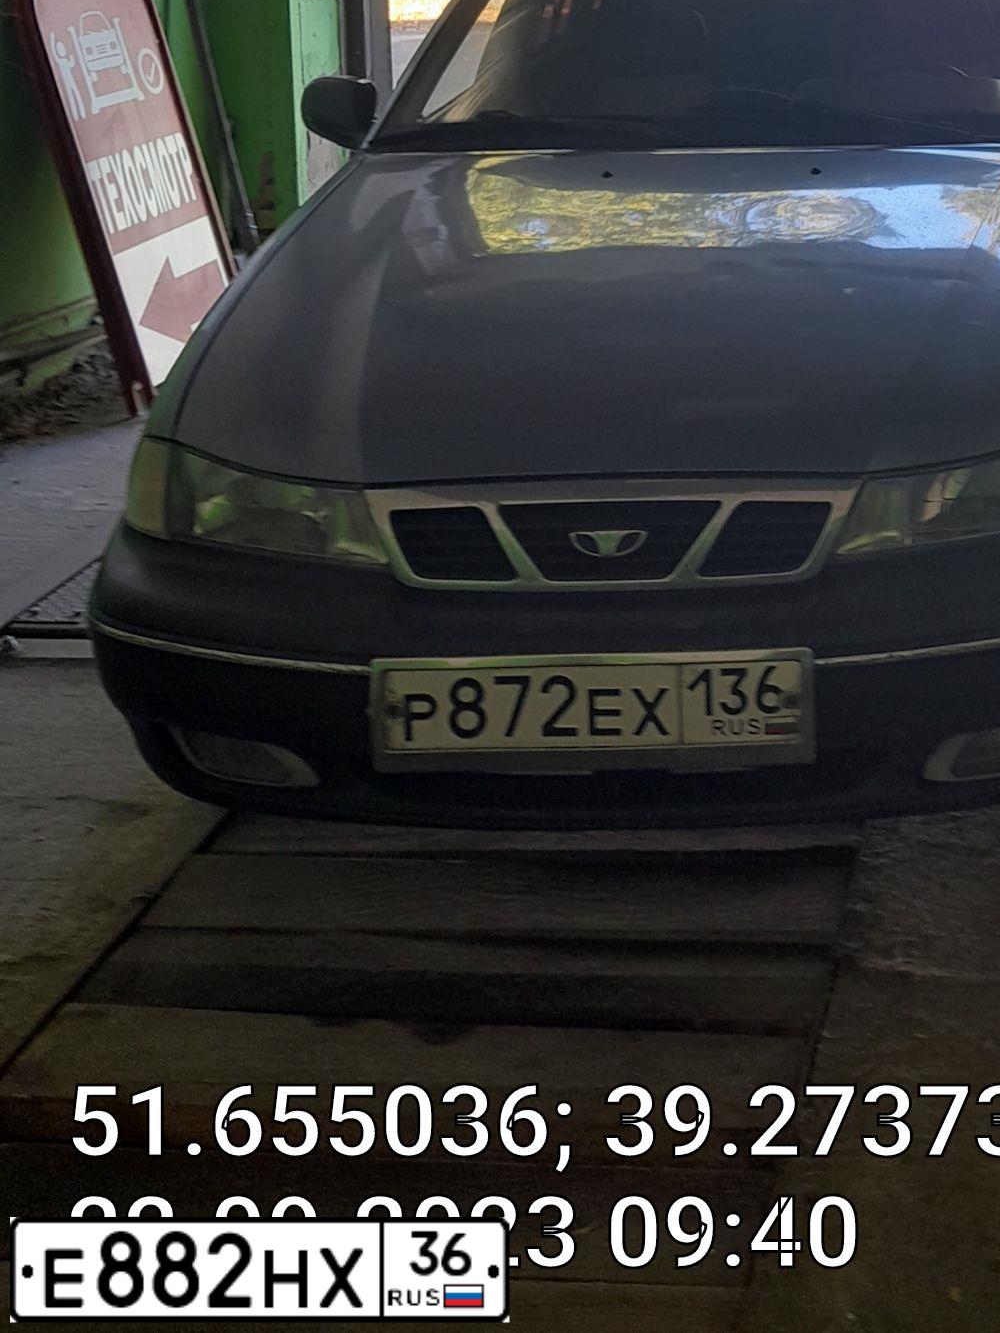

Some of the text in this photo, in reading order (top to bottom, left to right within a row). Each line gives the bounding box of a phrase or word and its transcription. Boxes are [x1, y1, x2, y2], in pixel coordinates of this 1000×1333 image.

[87, 132, 196, 234] ТЕХОСМОТР
[403, 665, 784, 741] Р872ЕХ 136
[711, 718, 761, 736] RUS
